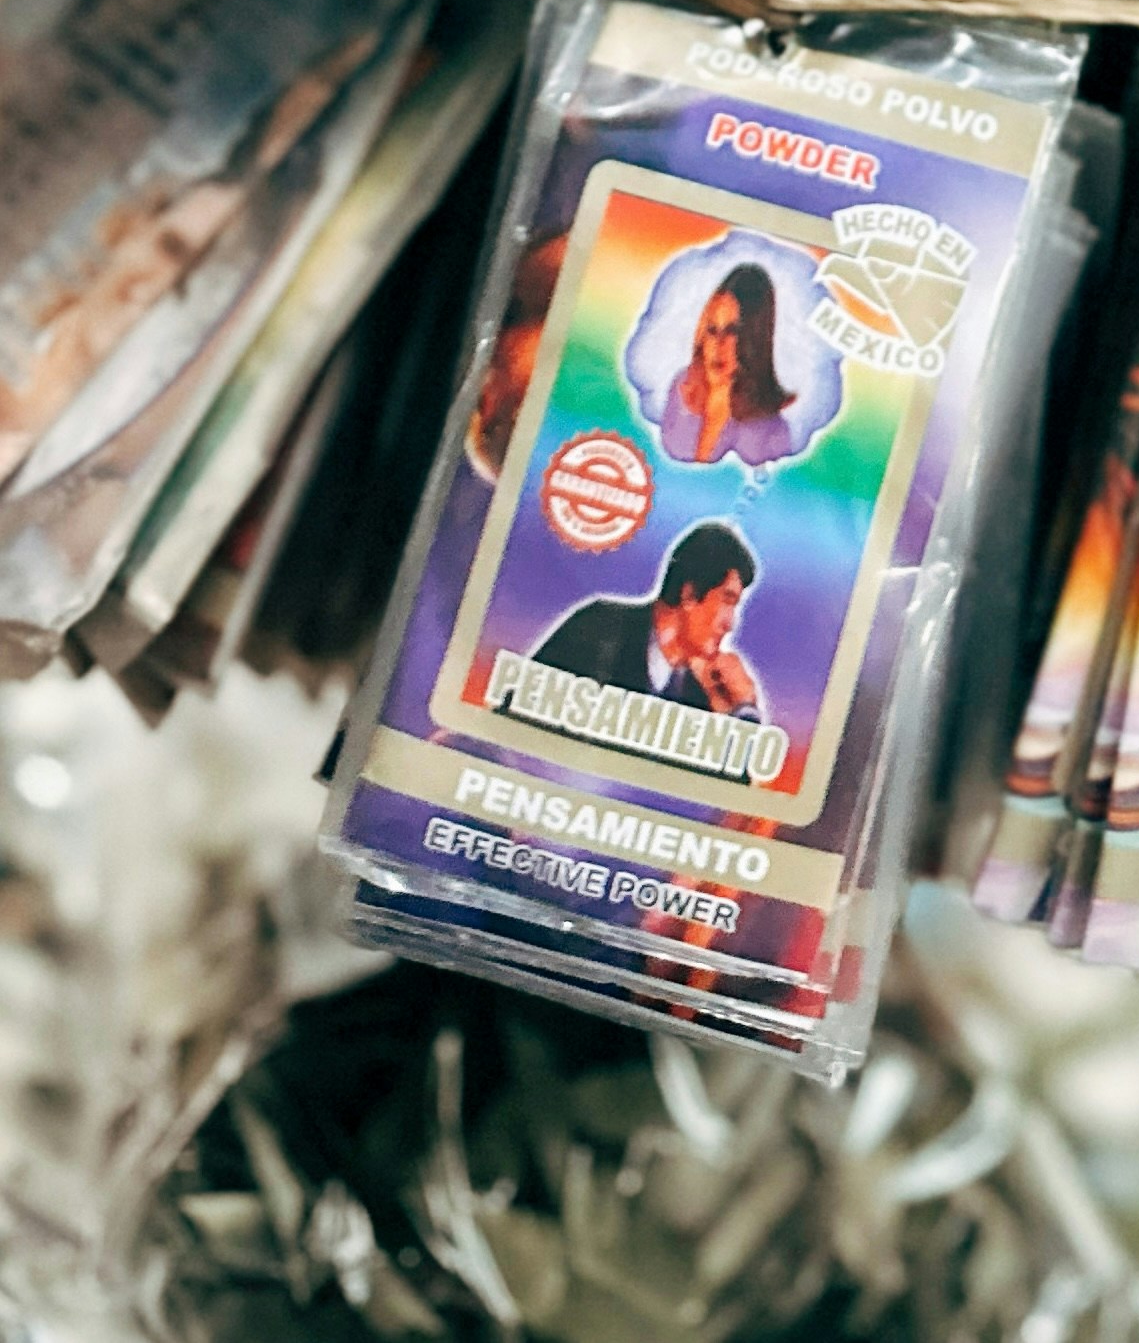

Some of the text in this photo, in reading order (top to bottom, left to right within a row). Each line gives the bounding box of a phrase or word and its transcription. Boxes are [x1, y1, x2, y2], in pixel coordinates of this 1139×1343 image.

[705, 112, 883, 193] POWDER
[880, 87, 999, 143] POLVO
[839, 208, 974, 267] HECHO EN
[813, 303, 942, 373] MEXICO
[484, 648, 790, 783] PENSAMIENTO
[454, 767, 772, 883] PENSAMIENTO
[423, 816, 742, 935] EFFECTIVE POWER
